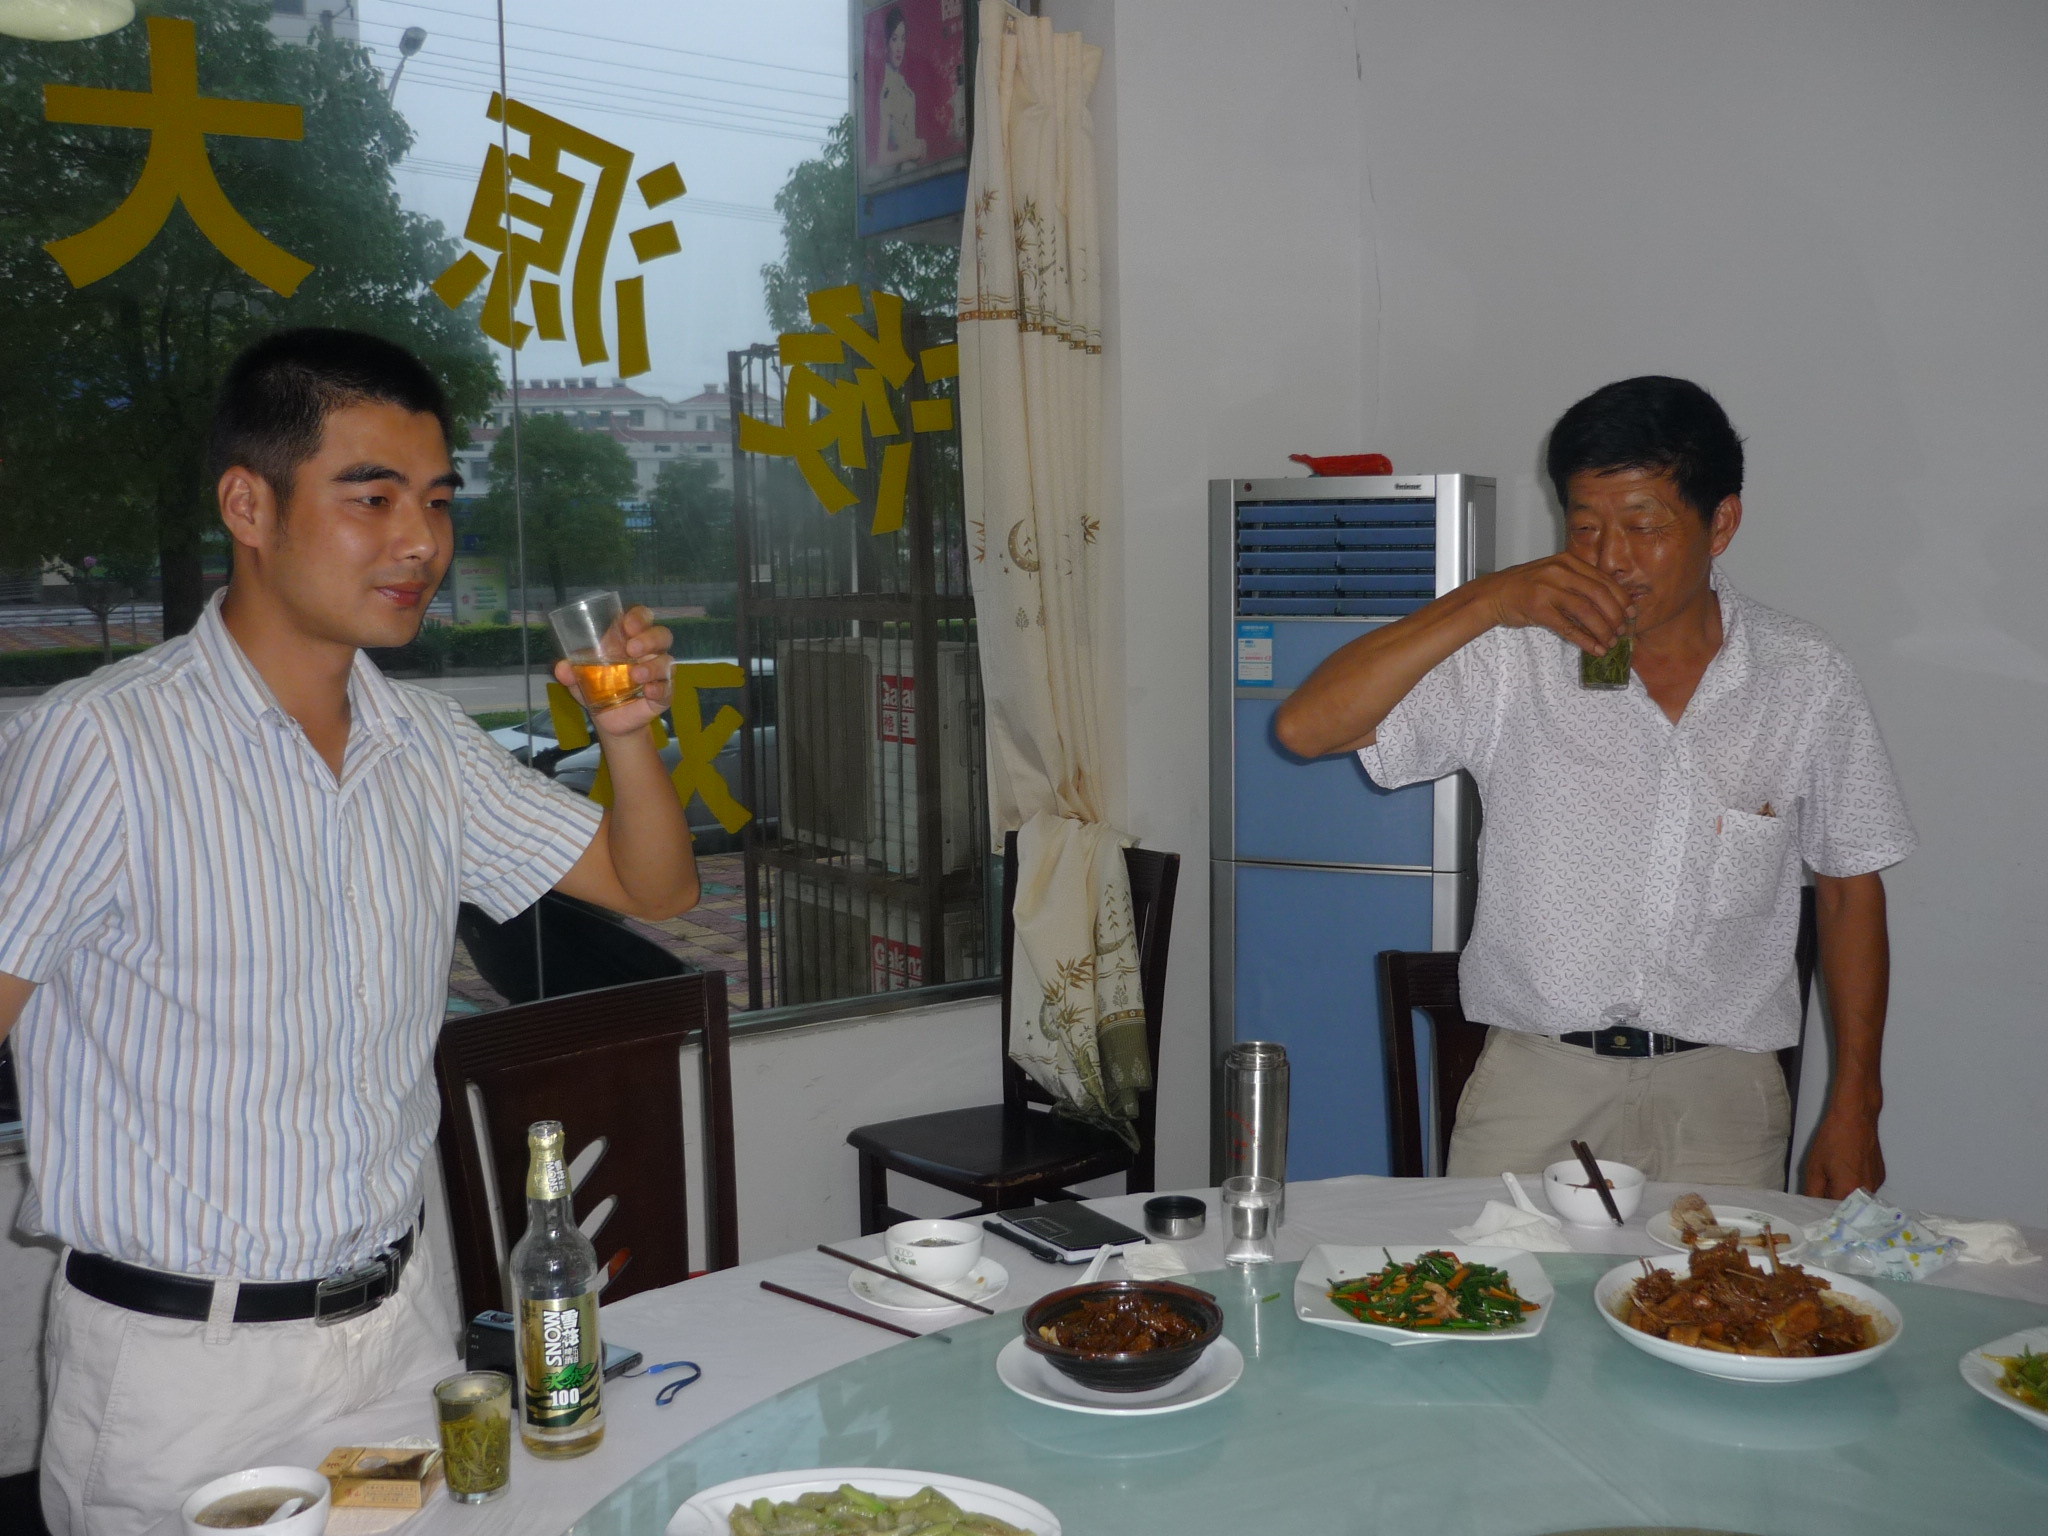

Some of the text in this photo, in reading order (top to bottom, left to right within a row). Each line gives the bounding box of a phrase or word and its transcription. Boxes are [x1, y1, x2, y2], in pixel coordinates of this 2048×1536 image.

[545, 1162, 558, 1192] SNOW
[543, 1310, 562, 1366] SNOW
[551, 1388, 580, 1406] 100
